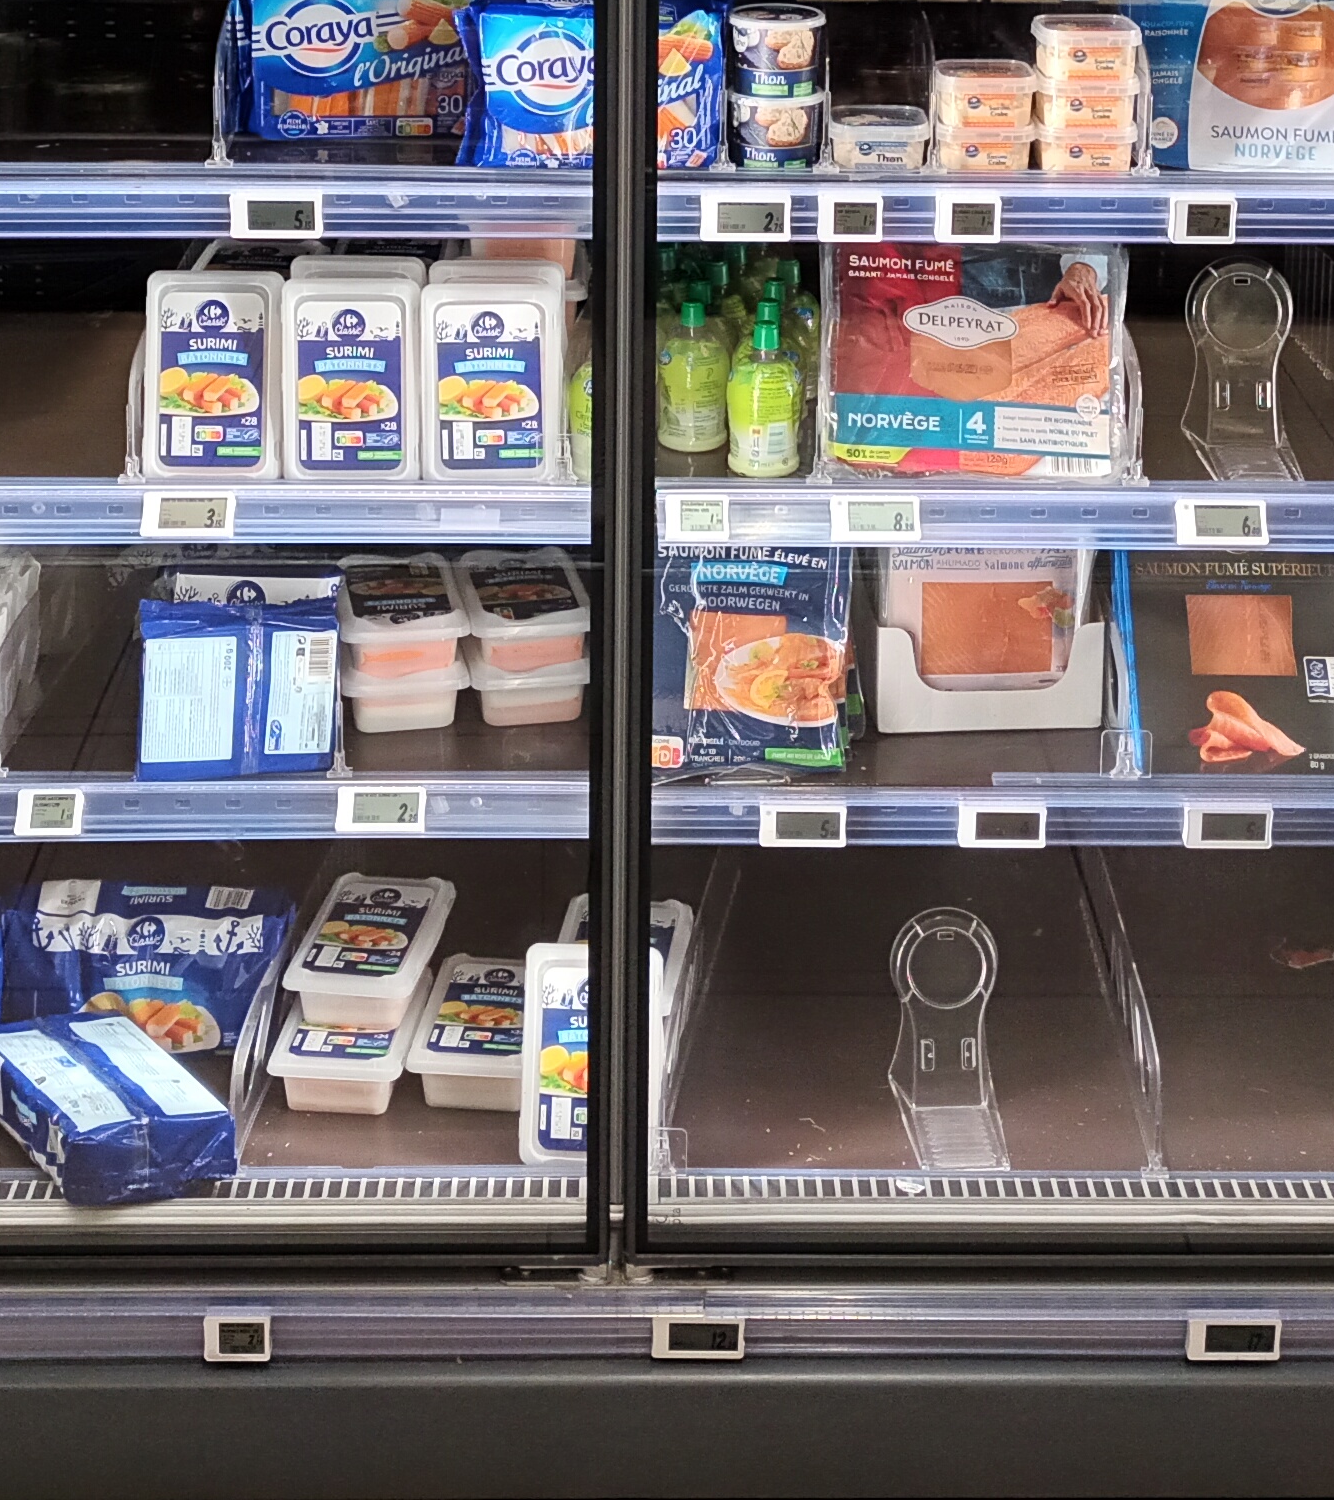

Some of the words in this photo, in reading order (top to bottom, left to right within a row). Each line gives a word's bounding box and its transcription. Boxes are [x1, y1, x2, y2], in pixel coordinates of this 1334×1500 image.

[265, 13, 376, 50] Coraya
[753, 71, 786, 86] Thon
[437, 95, 462, 115] 30
[670, 127, 698, 149] 30
[1210, 124, 1288, 142] SAUMON
[744, 147, 776, 163] Thon
[876, 153, 904, 164] Thon
[1234, 139, 1316, 161] NORVÈGE
[849, 254, 912, 271] SAUMON
[916, 255, 955, 273] FUMÉ
[918, 312, 1004, 333] DELPEYRAT
[189, 337, 238, 351] SURIMI
[325, 346, 374, 359] SURIMI
[465, 346, 515, 359] SURIMI
[240, 416, 258, 426] x28
[380, 421, 398, 431] x28
[521, 420, 539, 430] x28
[847, 409, 942, 433] NORVÈGE
[966, 416, 988, 435] 4
[699, 561, 780, 583] NORVÈGE
[1134, 563, 1202, 577] SAUMON
[1204, 559, 1248, 577] FUMÉ
[115, 960, 171, 977] SURIMI
[473, 985, 518, 997] SURIMI
